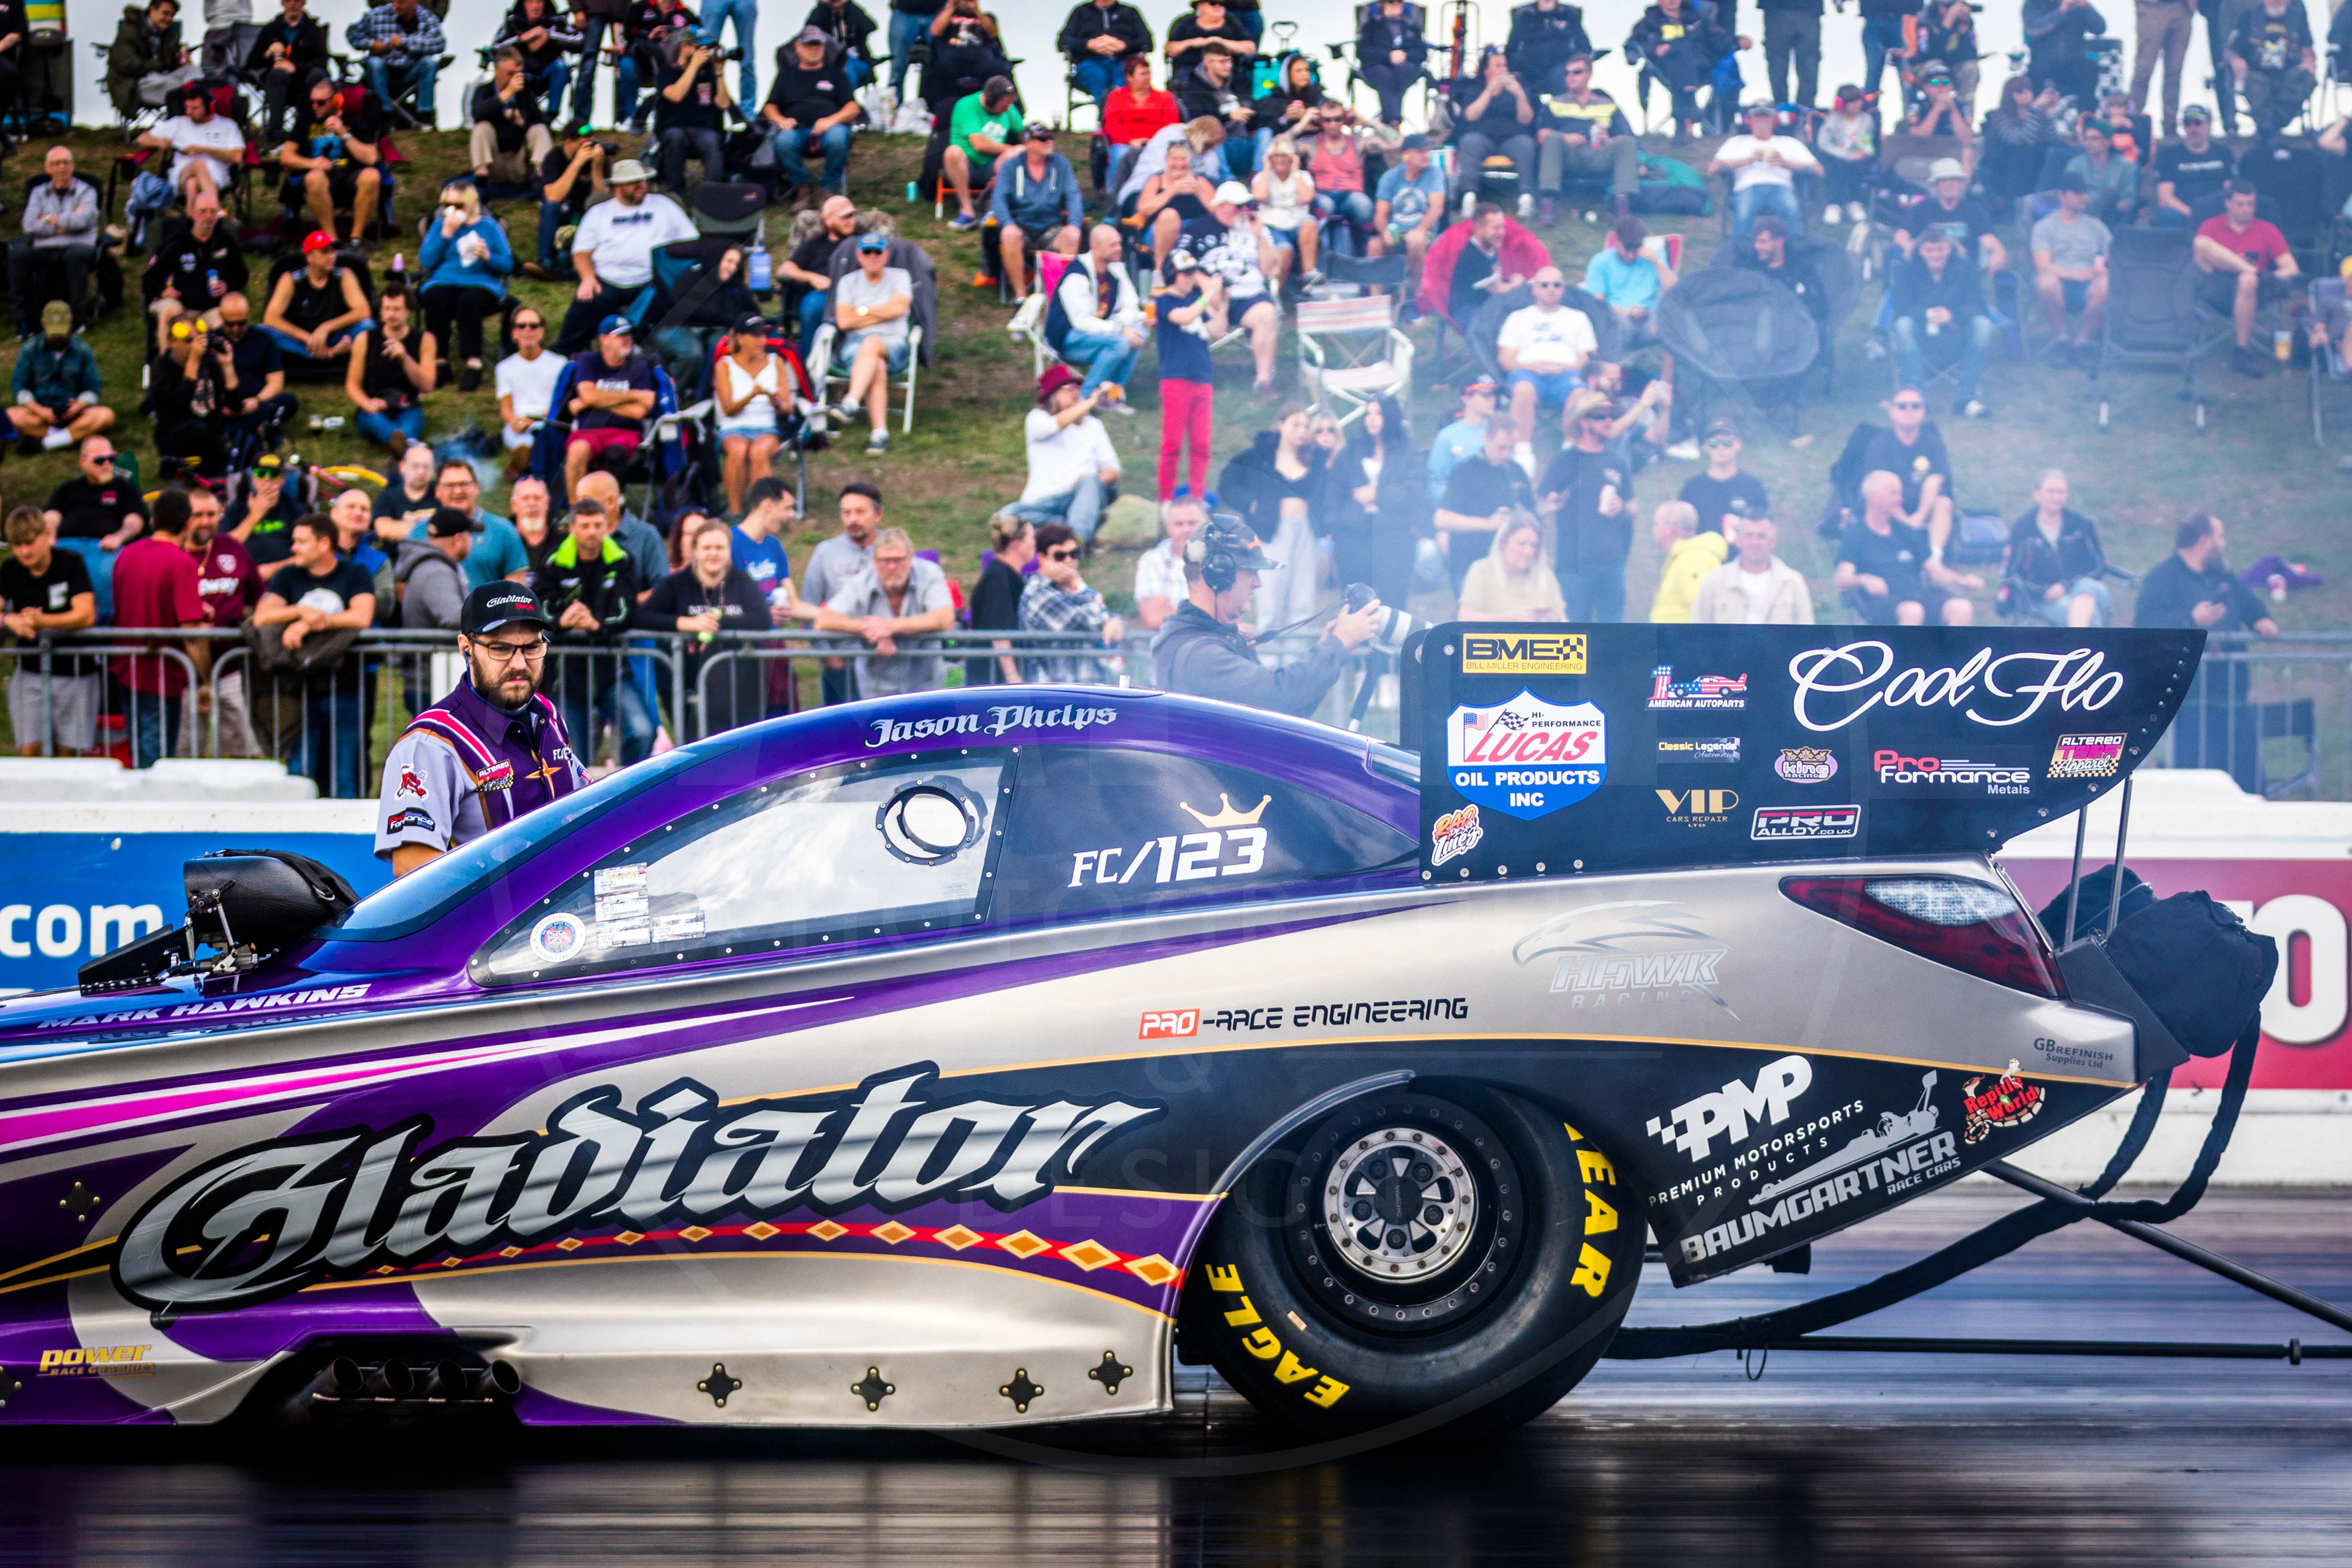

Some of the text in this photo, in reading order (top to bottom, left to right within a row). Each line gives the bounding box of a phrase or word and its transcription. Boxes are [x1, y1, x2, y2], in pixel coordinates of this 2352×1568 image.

[486, 595, 532, 608] Gladiator
[1466, 639, 1560, 660] BME
[1789, 641, 2124, 731] Cool Flo
[1648, 699, 1745, 708] AMERICAN AUTOPARTS
[864, 704, 1118, 748] Jason Phelps
[1463, 731, 1599, 763] LUCAS
[1658, 741, 1738, 752] Classic Legends
[1694, 750, 1733, 759] Automotiv
[1783, 761, 1830, 778] king
[1874, 750, 1940, 772] Pro
[2055, 755, 2111, 774] Apparel
[1455, 770, 1600, 787] OIL PRODUCTS
[1880, 766, 2030, 783] Formance
[1510, 793, 1545, 807] INC
[1987, 784, 2030, 794] Metals
[1655, 790, 1740, 815] VIP
[1758, 810, 1855, 828] PRO
[1067, 826, 1268, 888] FC/123
[1549, 949, 1728, 993] HAWK
[37, 984, 372, 1029] MARK HAWKINS
[1570, 990, 1693, 1009] RACING
[1294, 998, 1469, 1028] ENGINEERING
[2046, 1053, 2103, 1068] Supplies Ltd
[1671, 1055, 1813, 1163] PMP
[1963, 1076, 2039, 1121] Reptile World
[1649, 1099, 1864, 1207] PREMIUM MOTORSPORTS
[1697, 1137, 1828, 1205] PRODUCTS
[1887, 1158, 1962, 1196] RACE CARS
[116, 1070, 1161, 1314] Gladiator
[1680, 1130, 1958, 1265] BAUMGARTNER
[1204, 1263, 1351, 1408] EAGLE
[39, 1344, 152, 1372] power
[50, 1362, 155, 1376] RACE GRAPHICS
